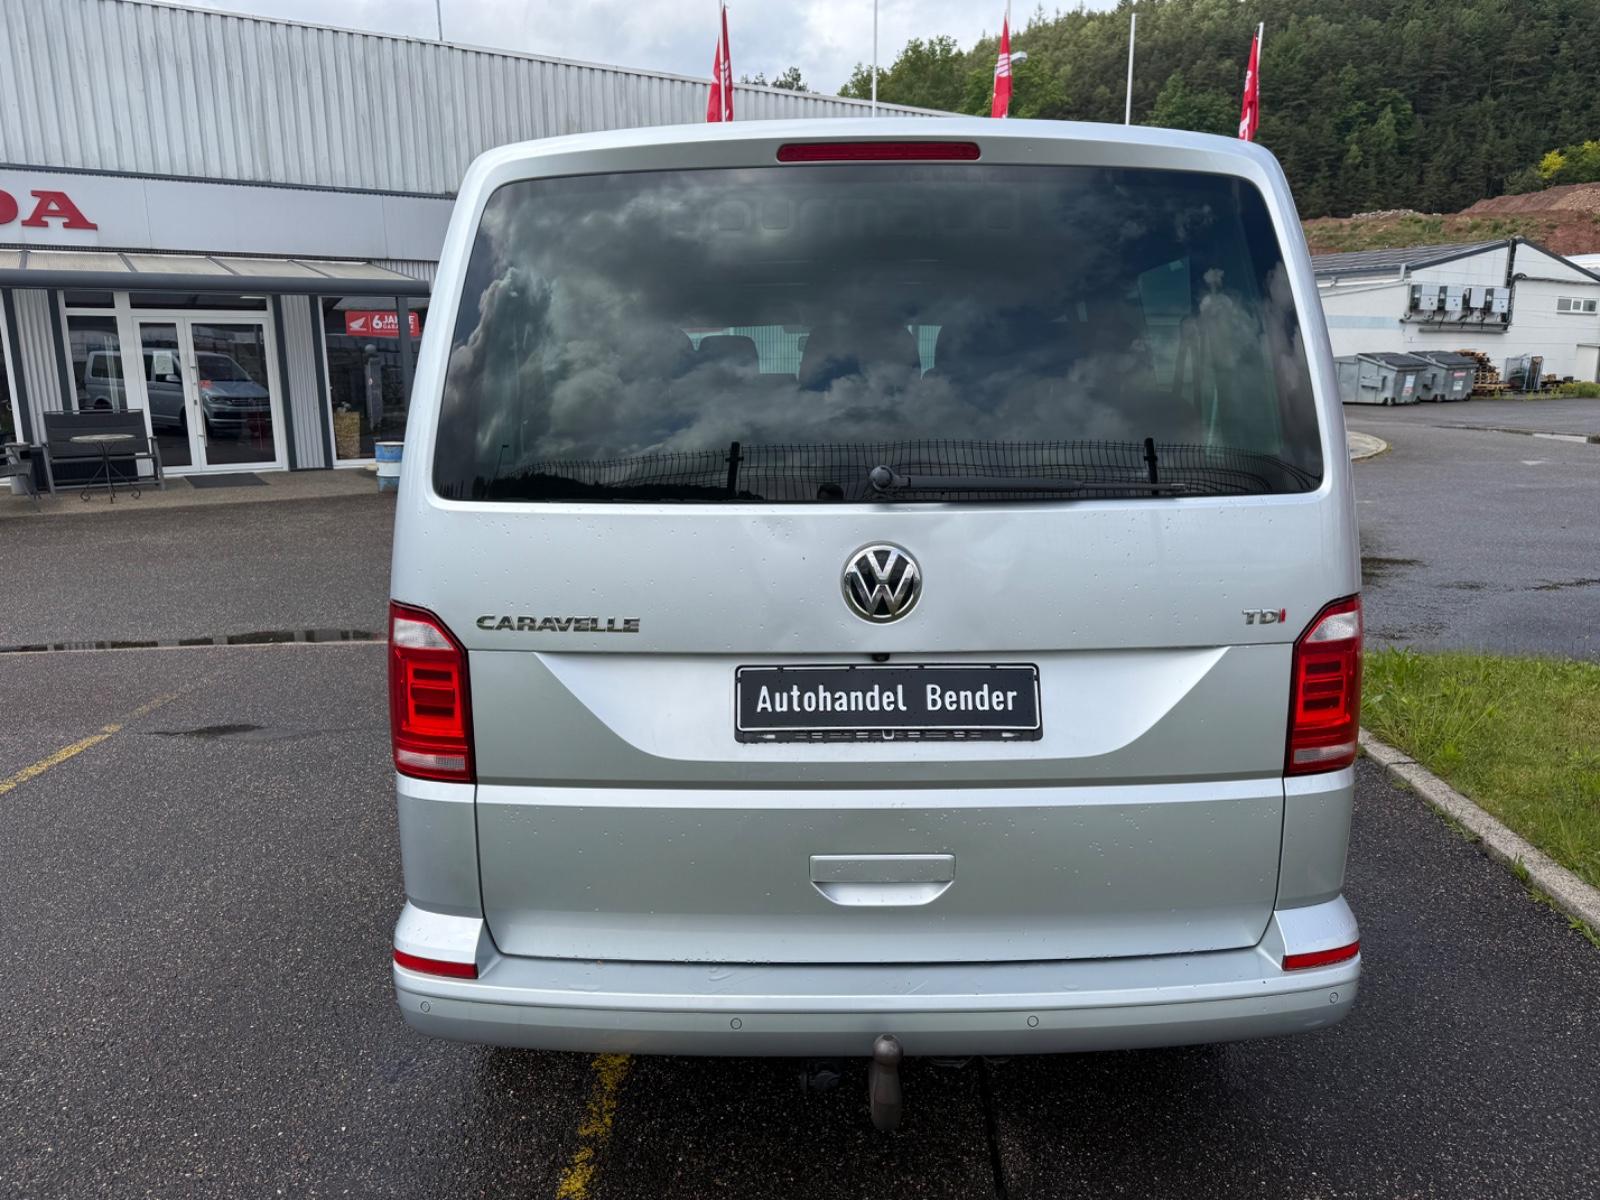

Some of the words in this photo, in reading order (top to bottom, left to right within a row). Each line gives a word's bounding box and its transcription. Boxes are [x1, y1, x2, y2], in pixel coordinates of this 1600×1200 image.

[372, 315, 383, 329] 6
[844, 546, 920, 618] VW
[476, 615, 640, 633] CARAVELLE
[1242, 608, 1286, 625] TDI
[756, 684, 908, 712] Autohandel
[926, 684, 1017, 711] Bender
